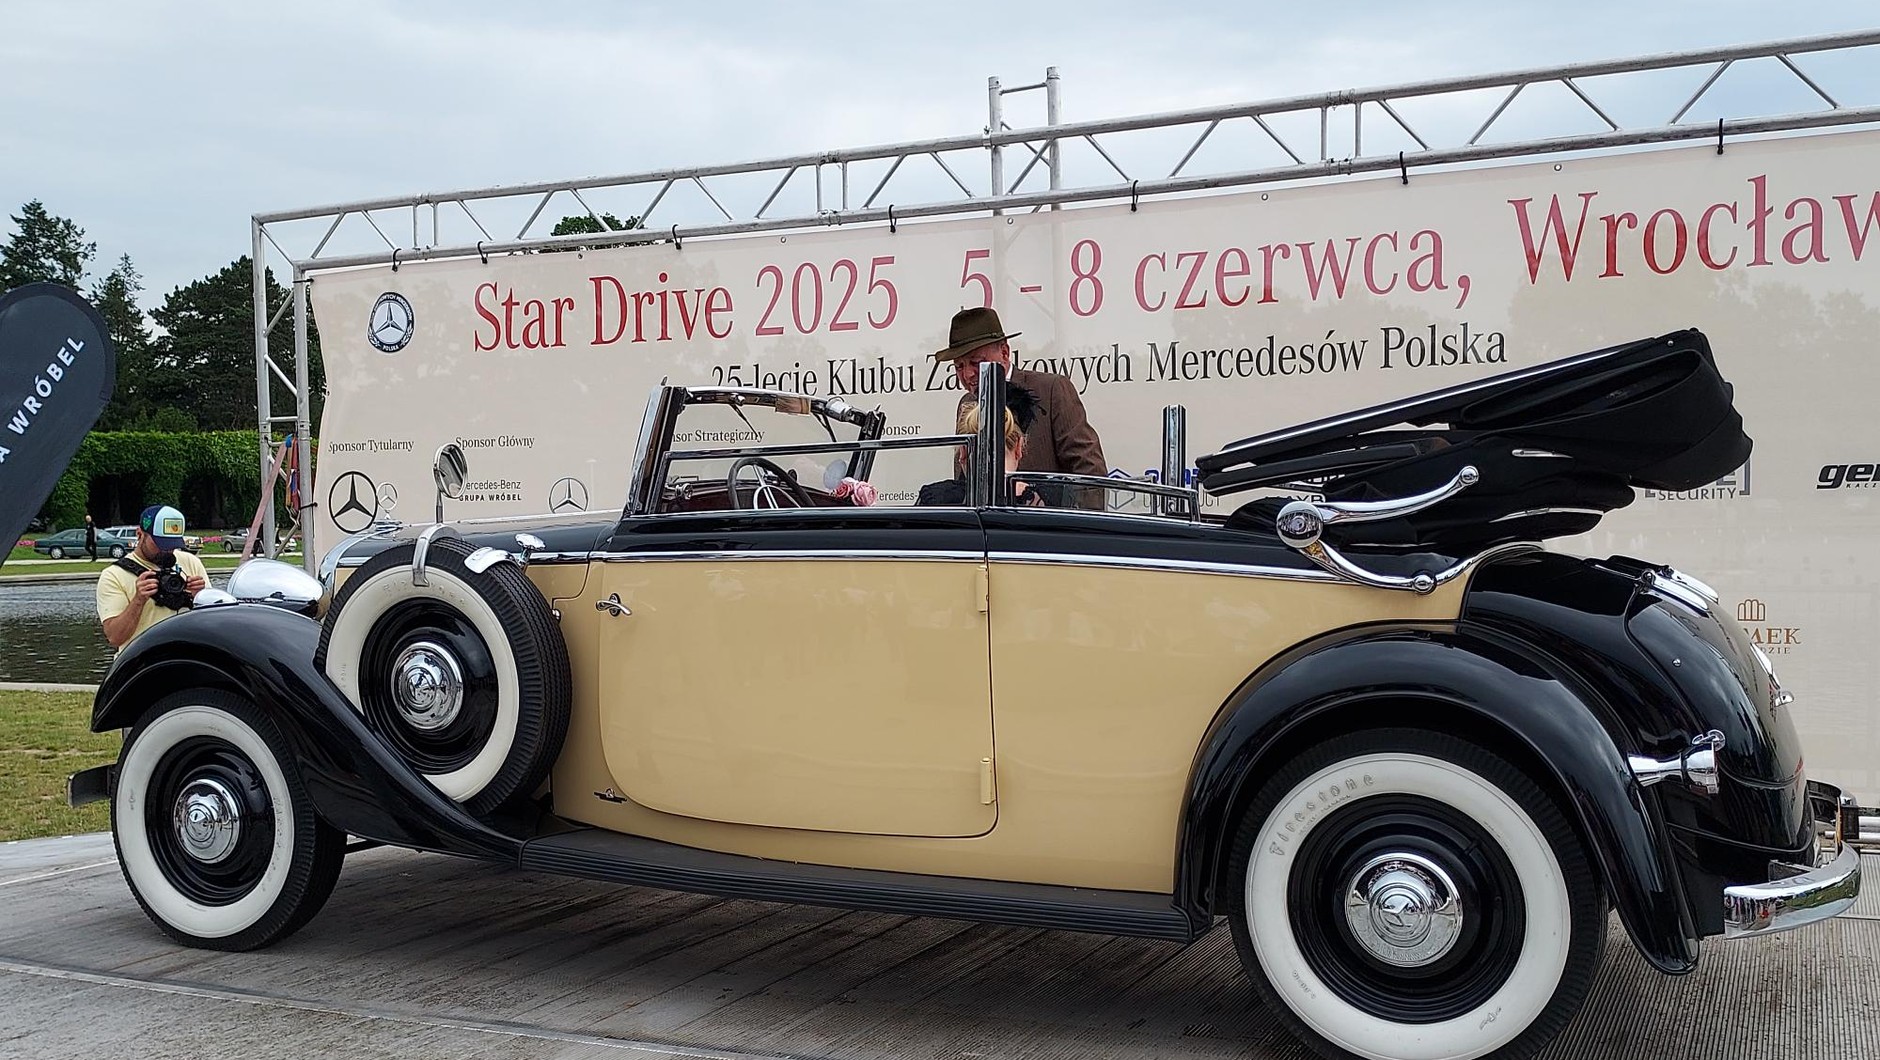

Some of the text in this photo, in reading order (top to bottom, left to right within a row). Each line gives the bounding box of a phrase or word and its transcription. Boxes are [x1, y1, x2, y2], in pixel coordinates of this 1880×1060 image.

[473, 281, 575, 352] Star
[589, 272, 734, 347] Drive
[755, 256, 898, 337] 2025
[960, 248, 994, 309] 5
[1069, 238, 1105, 317] 8
[1134, 229, 1472, 310] czerwca,
[1507, 174, 1880, 285] Wrocław
[711, 362, 818, 397] 25-lecie
[827, 357, 916, 396] Klubu
[1146, 329, 1368, 383] Mercedesów
[1380, 322, 1507, 370] Polska
[7, 337, 85, 435] WRÓBEL
[455, 435, 535, 451] Sponsor Główny
[695, 429, 765, 443] Strategiczny
[329, 439, 414, 454] Sponsor Tytularny
[466, 479, 522, 490] ercedes-Benz
[488, 492, 522, 501] WRÓBEL
[1658, 487, 1737, 500] SECURITY
